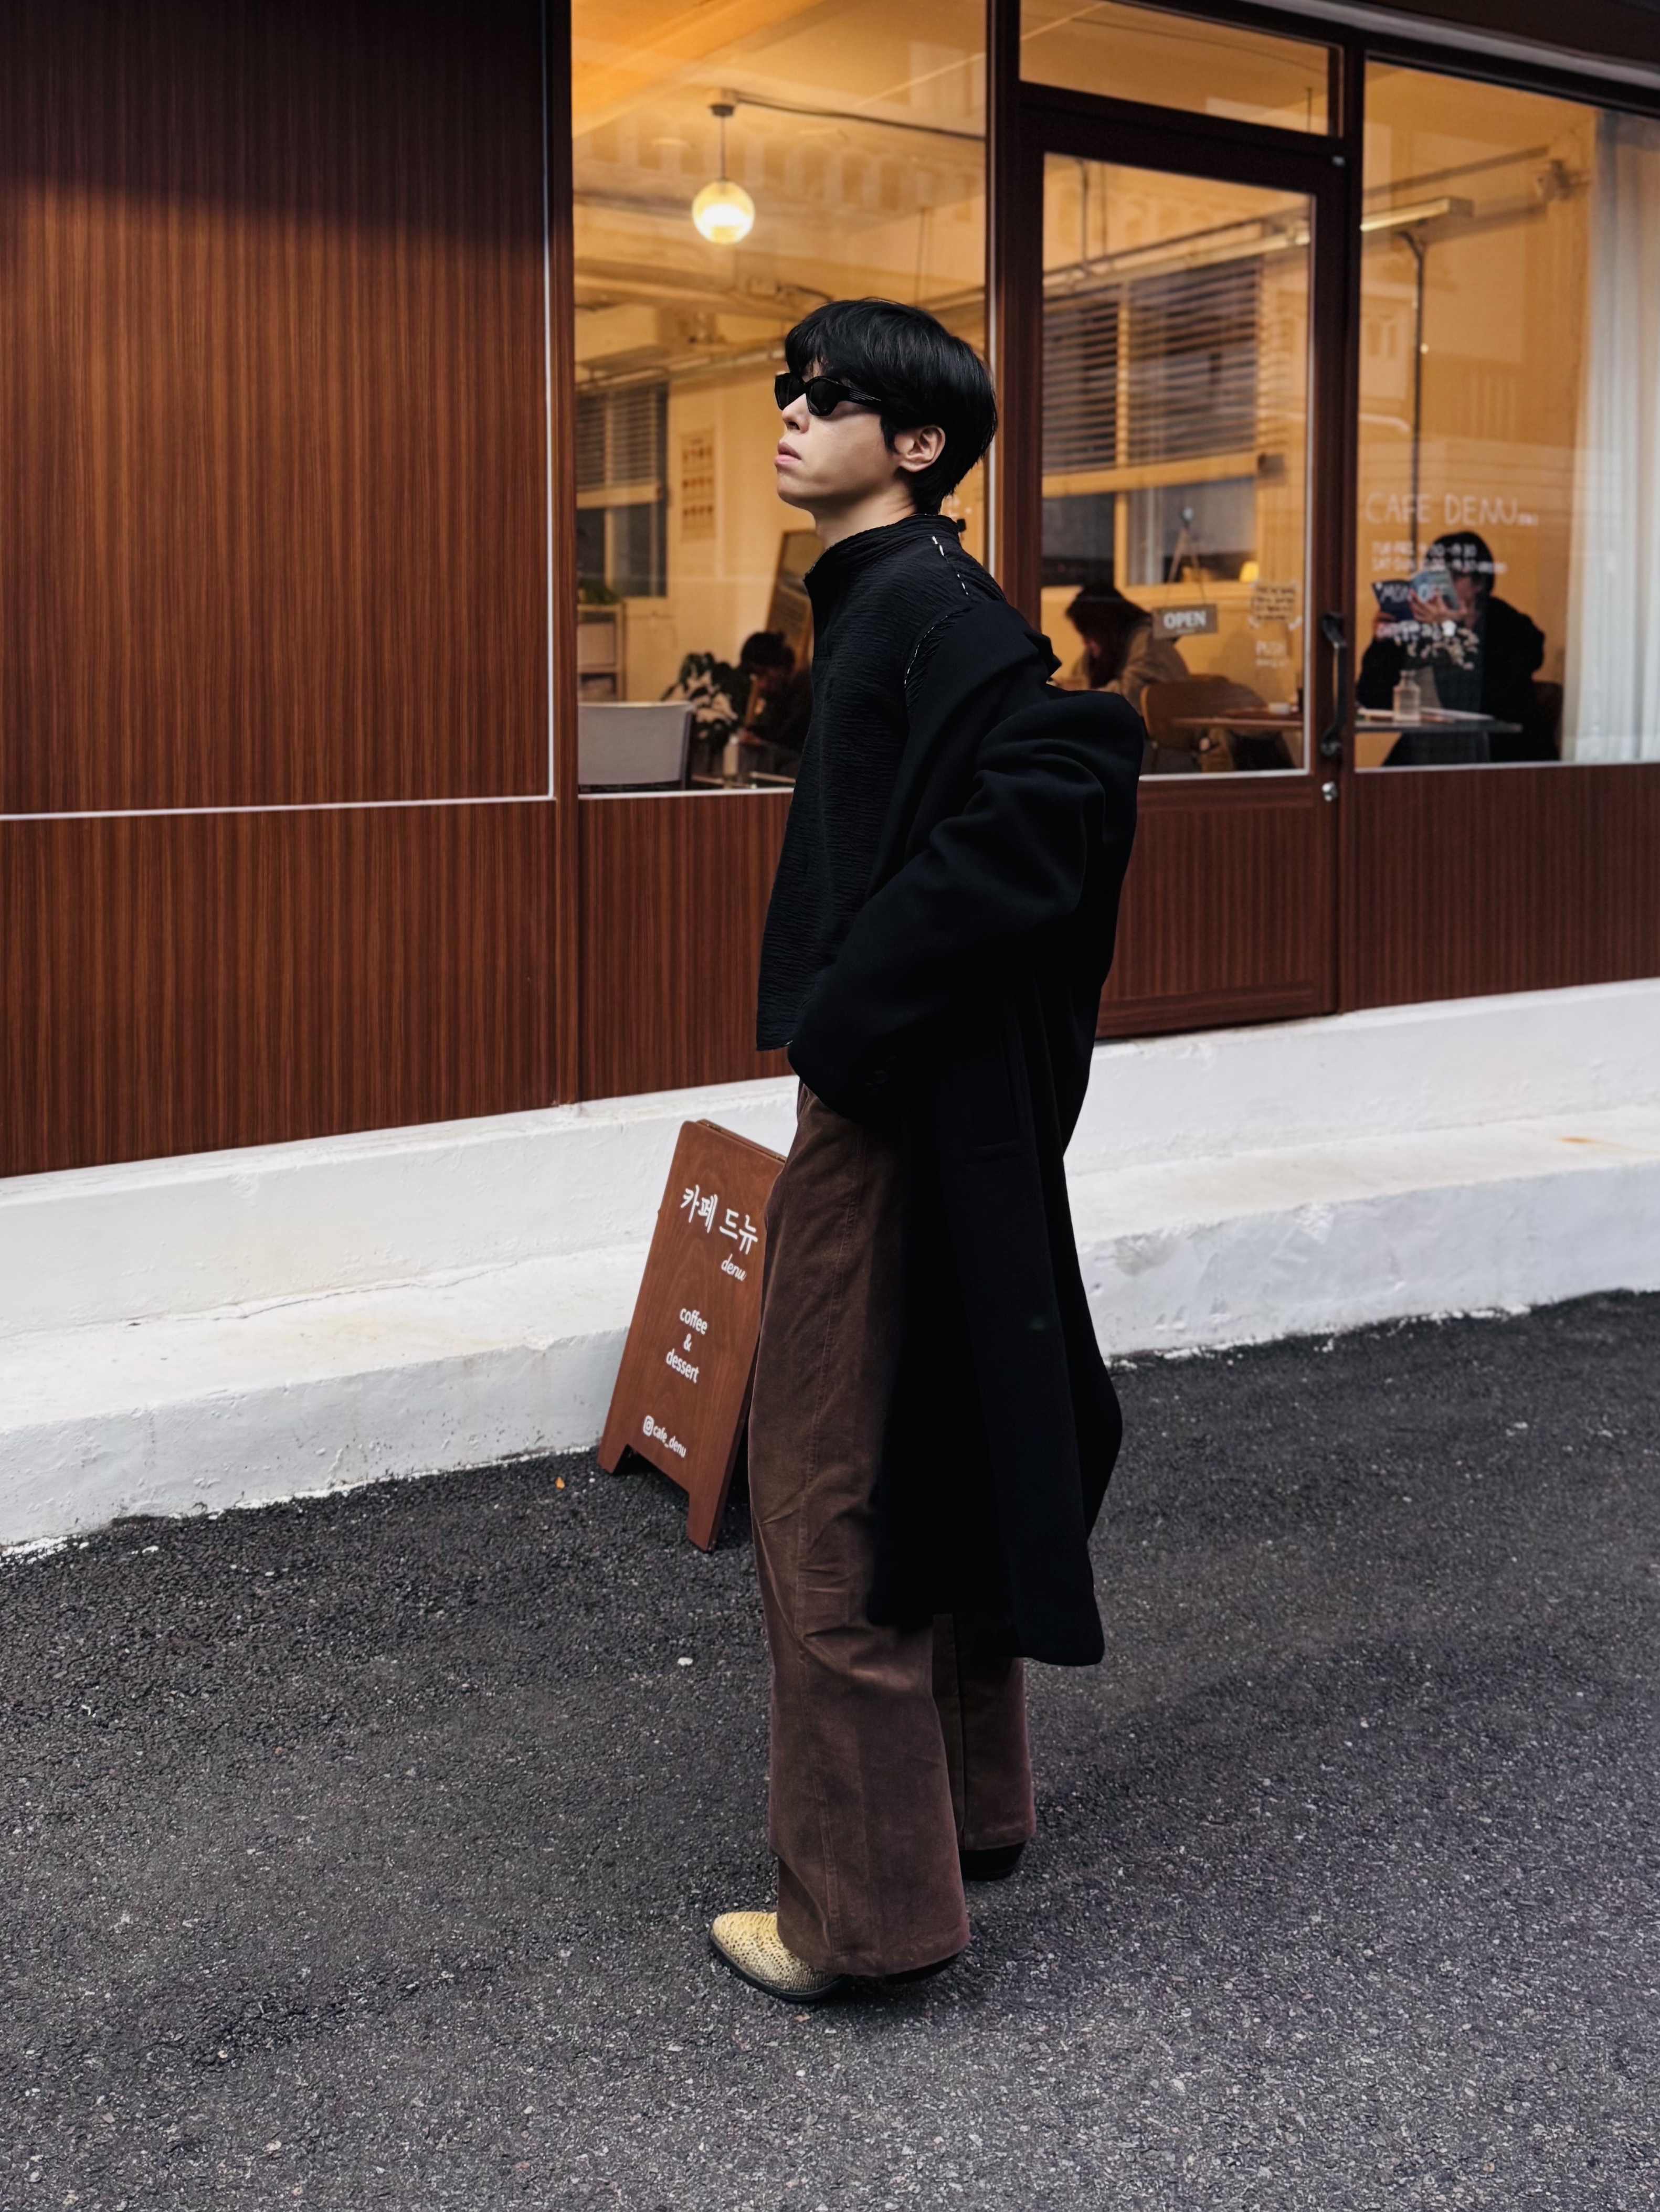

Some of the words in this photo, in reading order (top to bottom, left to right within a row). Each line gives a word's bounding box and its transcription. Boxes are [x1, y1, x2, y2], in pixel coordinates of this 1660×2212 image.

[1366, 492, 1431, 524] CAFE
[1164, 610, 1207, 629] OPEN
[680, 1184, 718, 1233] 카페
[719, 1208, 758, 1255] 드뉴
[721, 1253, 747, 1281] denu
[680, 1308, 707, 1335] coffee
[683, 1333, 692, 1352] &
[665, 1348, 700, 1384] dessert
